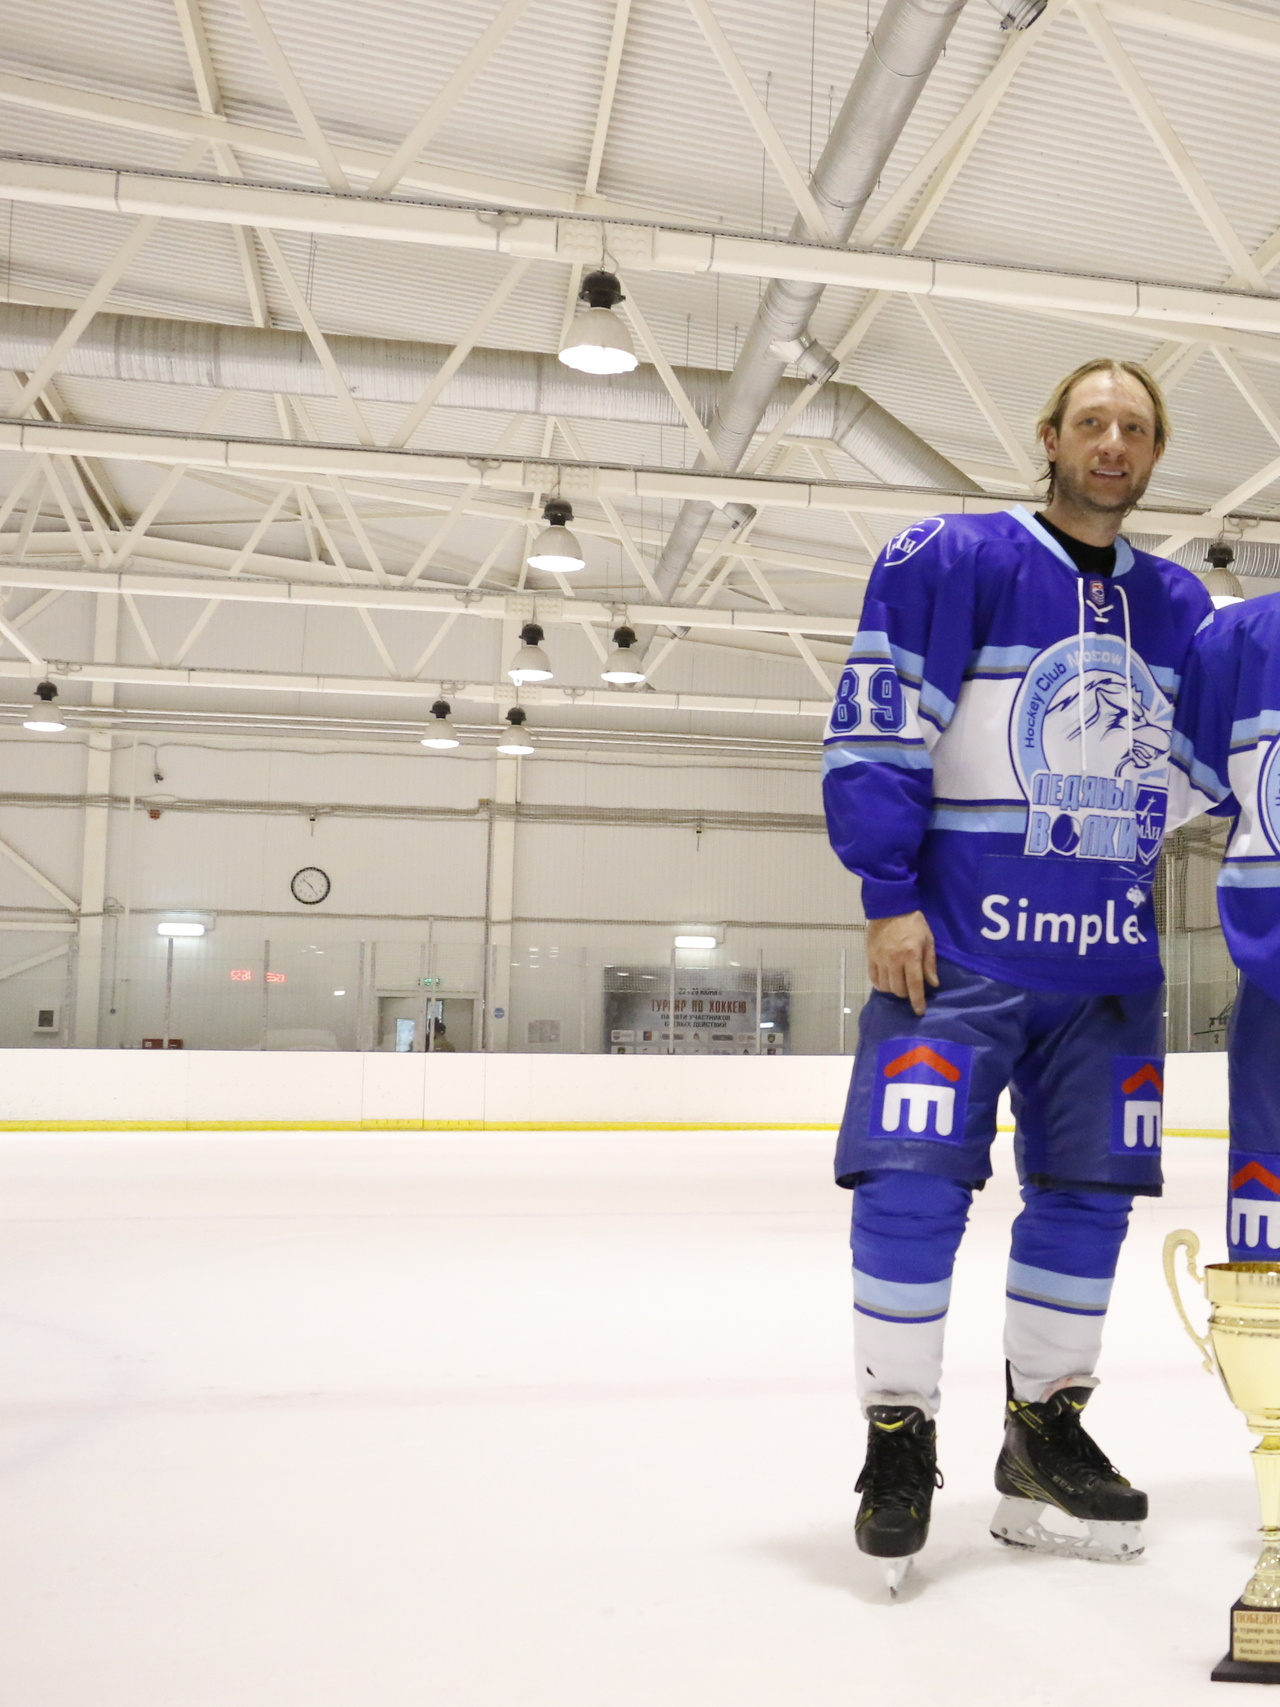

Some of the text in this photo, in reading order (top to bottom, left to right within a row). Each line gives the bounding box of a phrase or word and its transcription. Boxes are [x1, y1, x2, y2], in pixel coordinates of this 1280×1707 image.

[829, 667, 907, 734] 89
[1025, 650, 1124, 748] Hockey Club Moscow
[1033, 773, 1137, 811] ЛЕДЯНЫ
[691, 1000, 704, 1013] ПО
[708, 1001, 747, 1014] ХОККЕЮ
[693, 1020, 727, 1028] ДЕЙСТВИЙ
